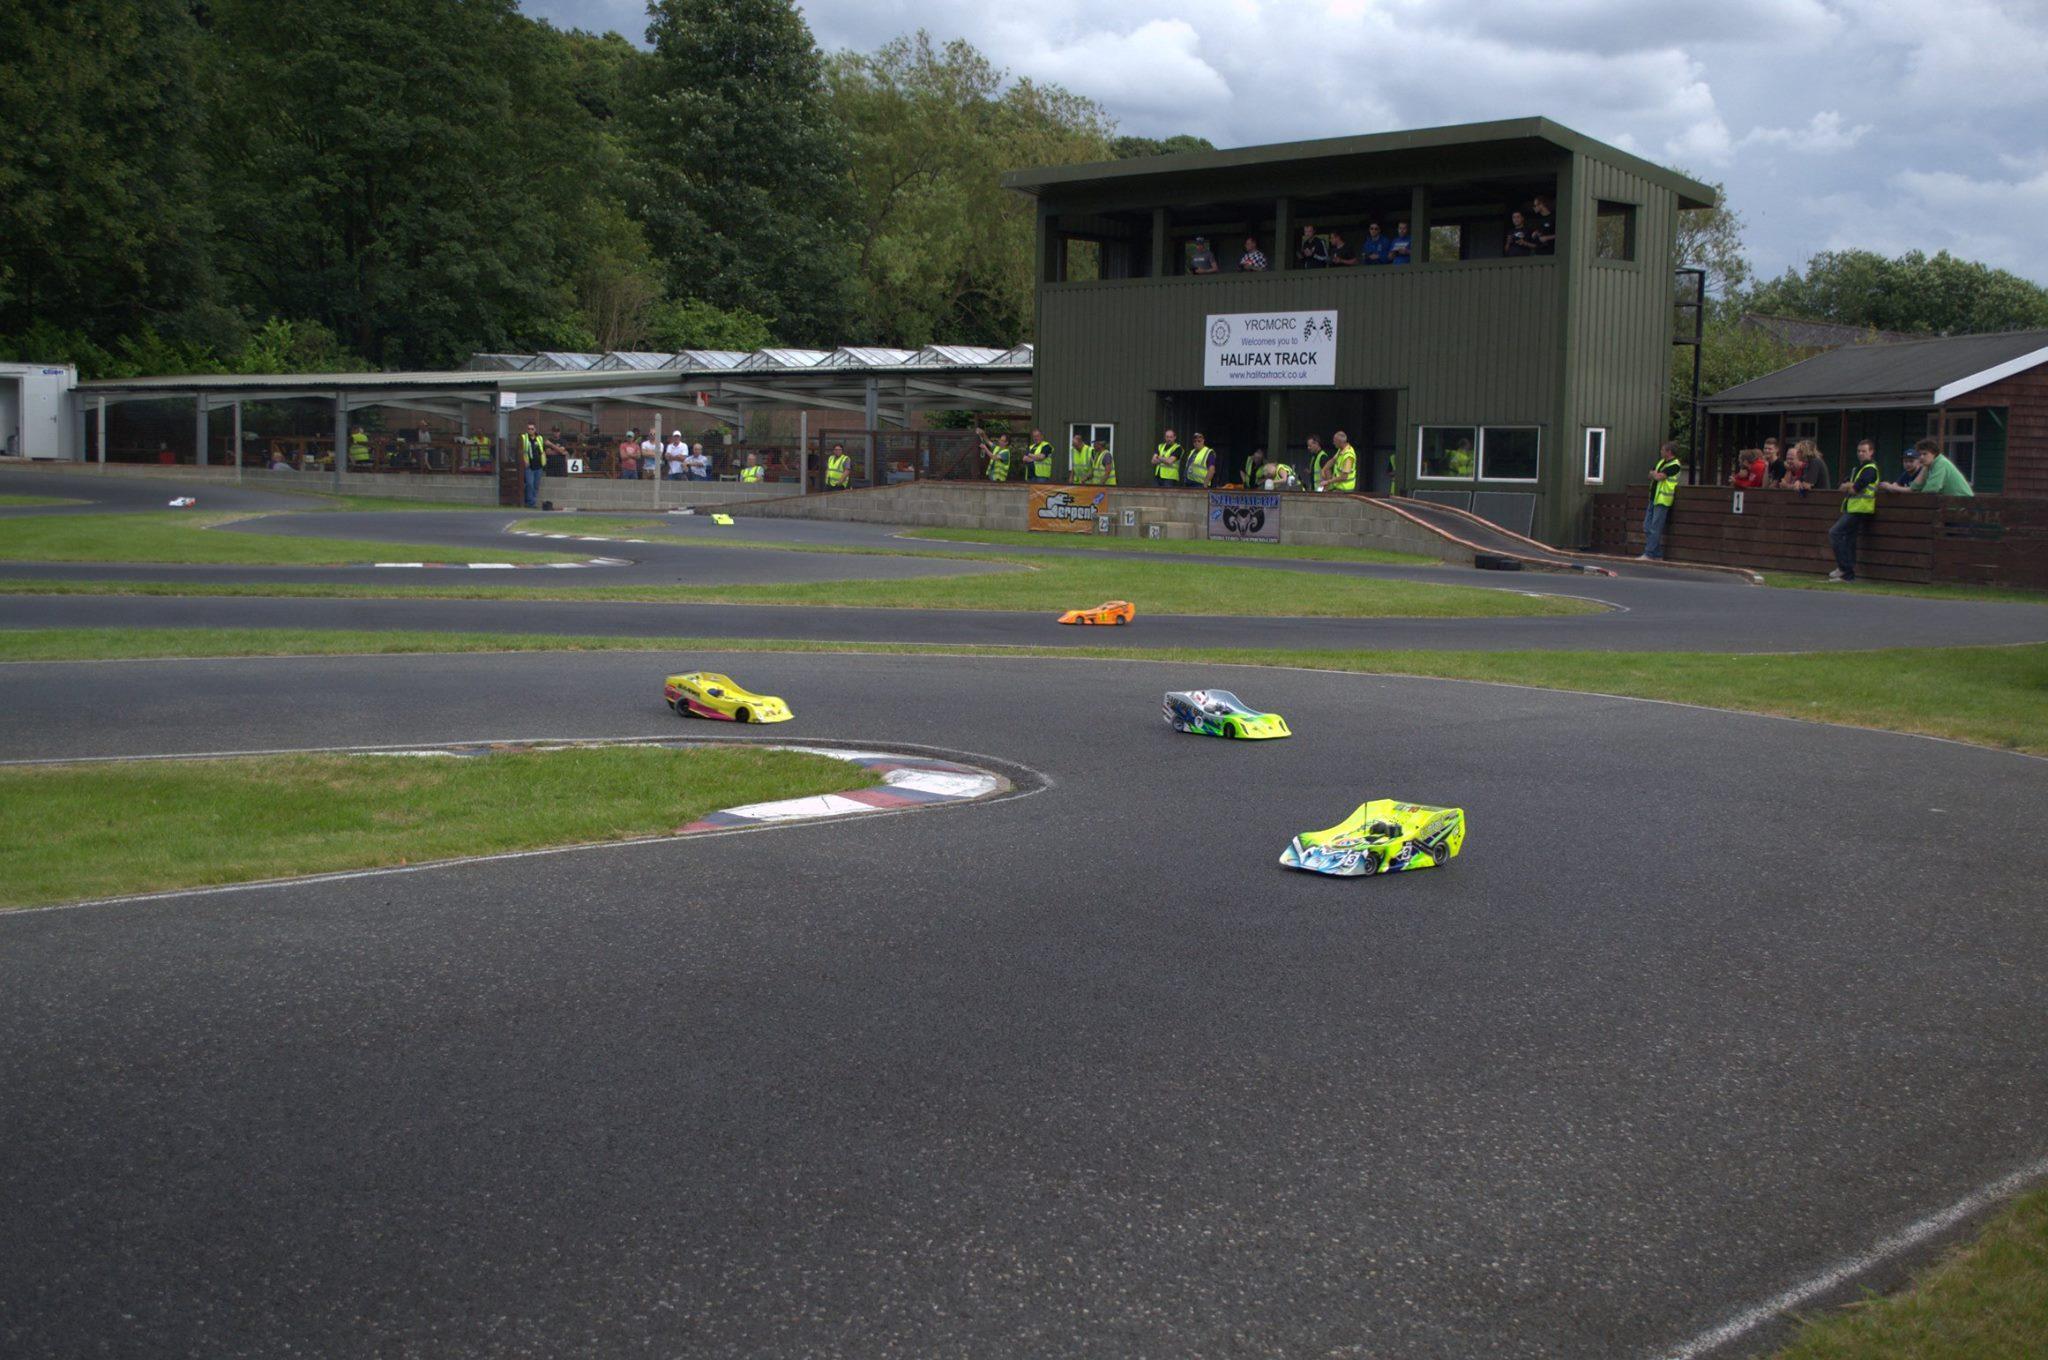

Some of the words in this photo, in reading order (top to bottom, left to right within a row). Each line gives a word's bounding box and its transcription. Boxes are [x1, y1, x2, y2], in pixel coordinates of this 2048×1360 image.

[1244, 318, 1297, 331] YRCMCRC
[1241, 338, 1276, 346] Welcomes
[1277, 338, 1290, 347] you
[1291, 337, 1298, 345] to
[1220, 353, 1272, 366] HALIFAX
[1275, 352, 1318, 366] TRACK
[1229, 370, 1307, 380] www.halifaxtrack.co.uk
[571, 460, 579, 472] 6
